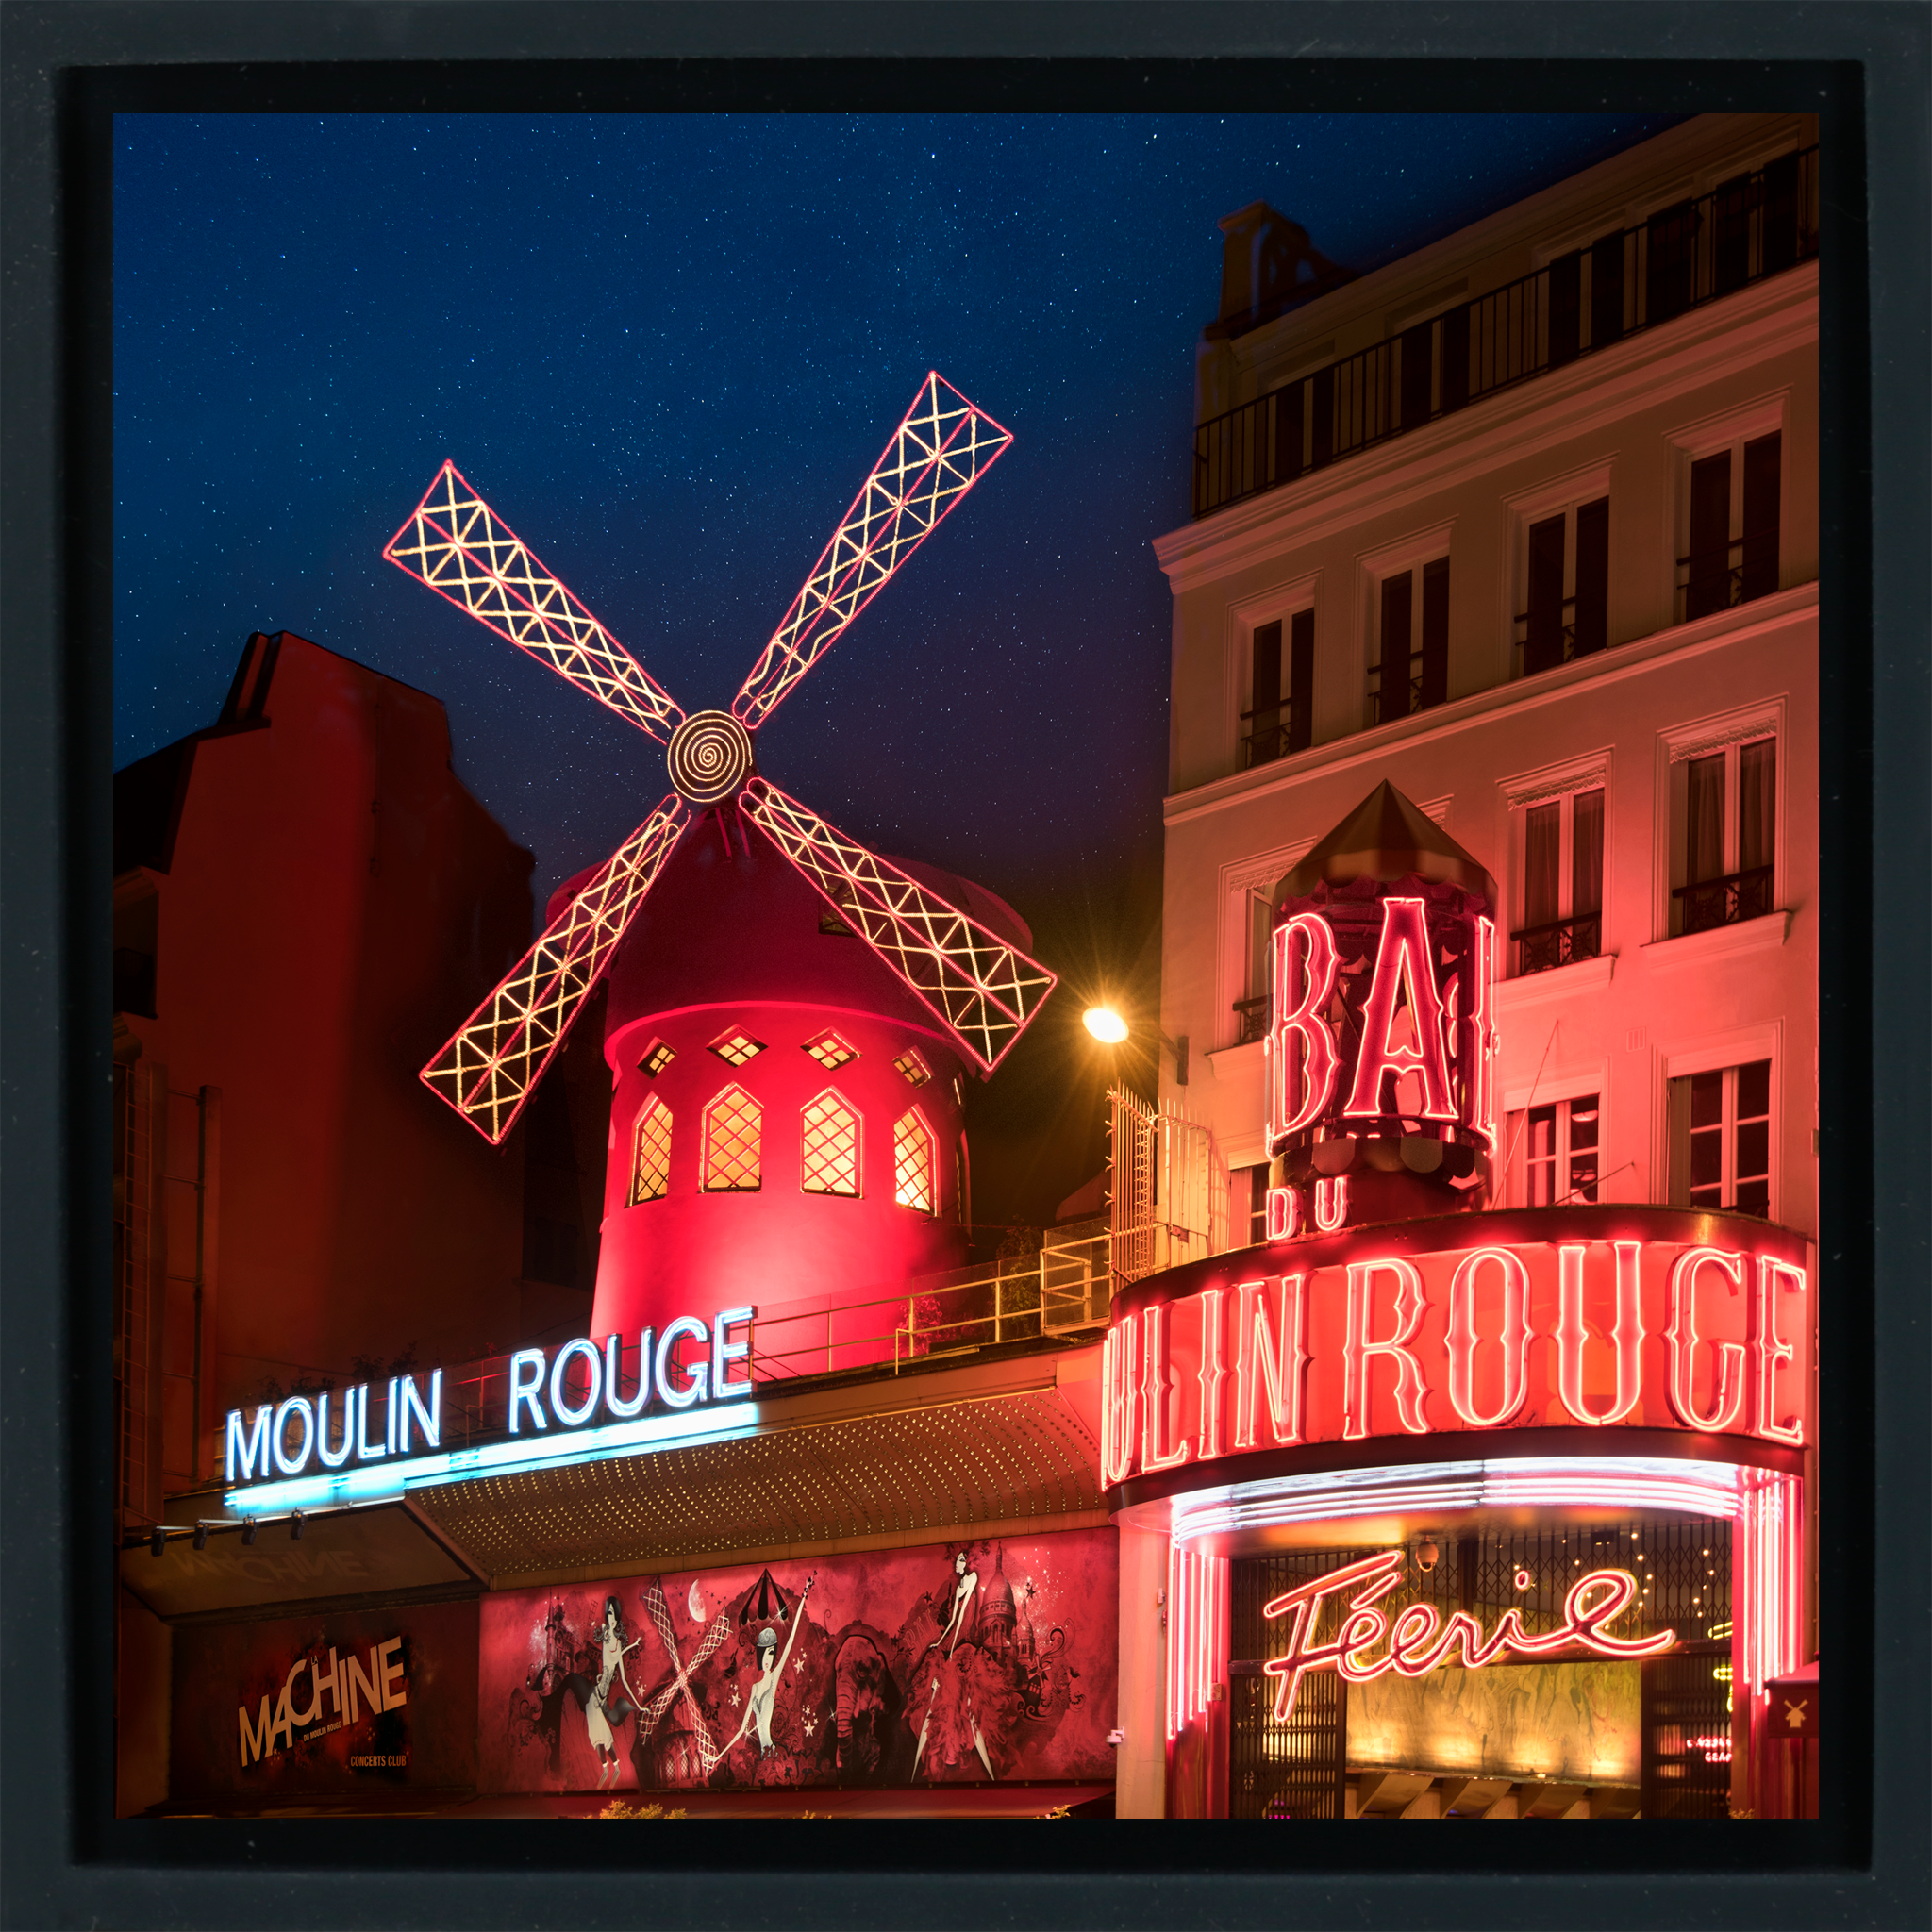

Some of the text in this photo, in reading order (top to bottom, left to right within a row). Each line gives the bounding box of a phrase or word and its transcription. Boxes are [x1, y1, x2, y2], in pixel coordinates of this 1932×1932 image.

[1265, 1176, 1347, 1241] DU
[225, 1305, 758, 1482] MOULIN ROUGE
[1101, 1241, 1806, 1491] ULIN ROUGE
[310, 1655, 319, 1665] LA
[1263, 1550, 1676, 1723] Féerie
[239, 1636, 407, 1768] MACHINE
[303, 1721, 341, 1741] DU MOULIN ROUGE
[350, 1755, 407, 1767] CONCERTS CLUB
